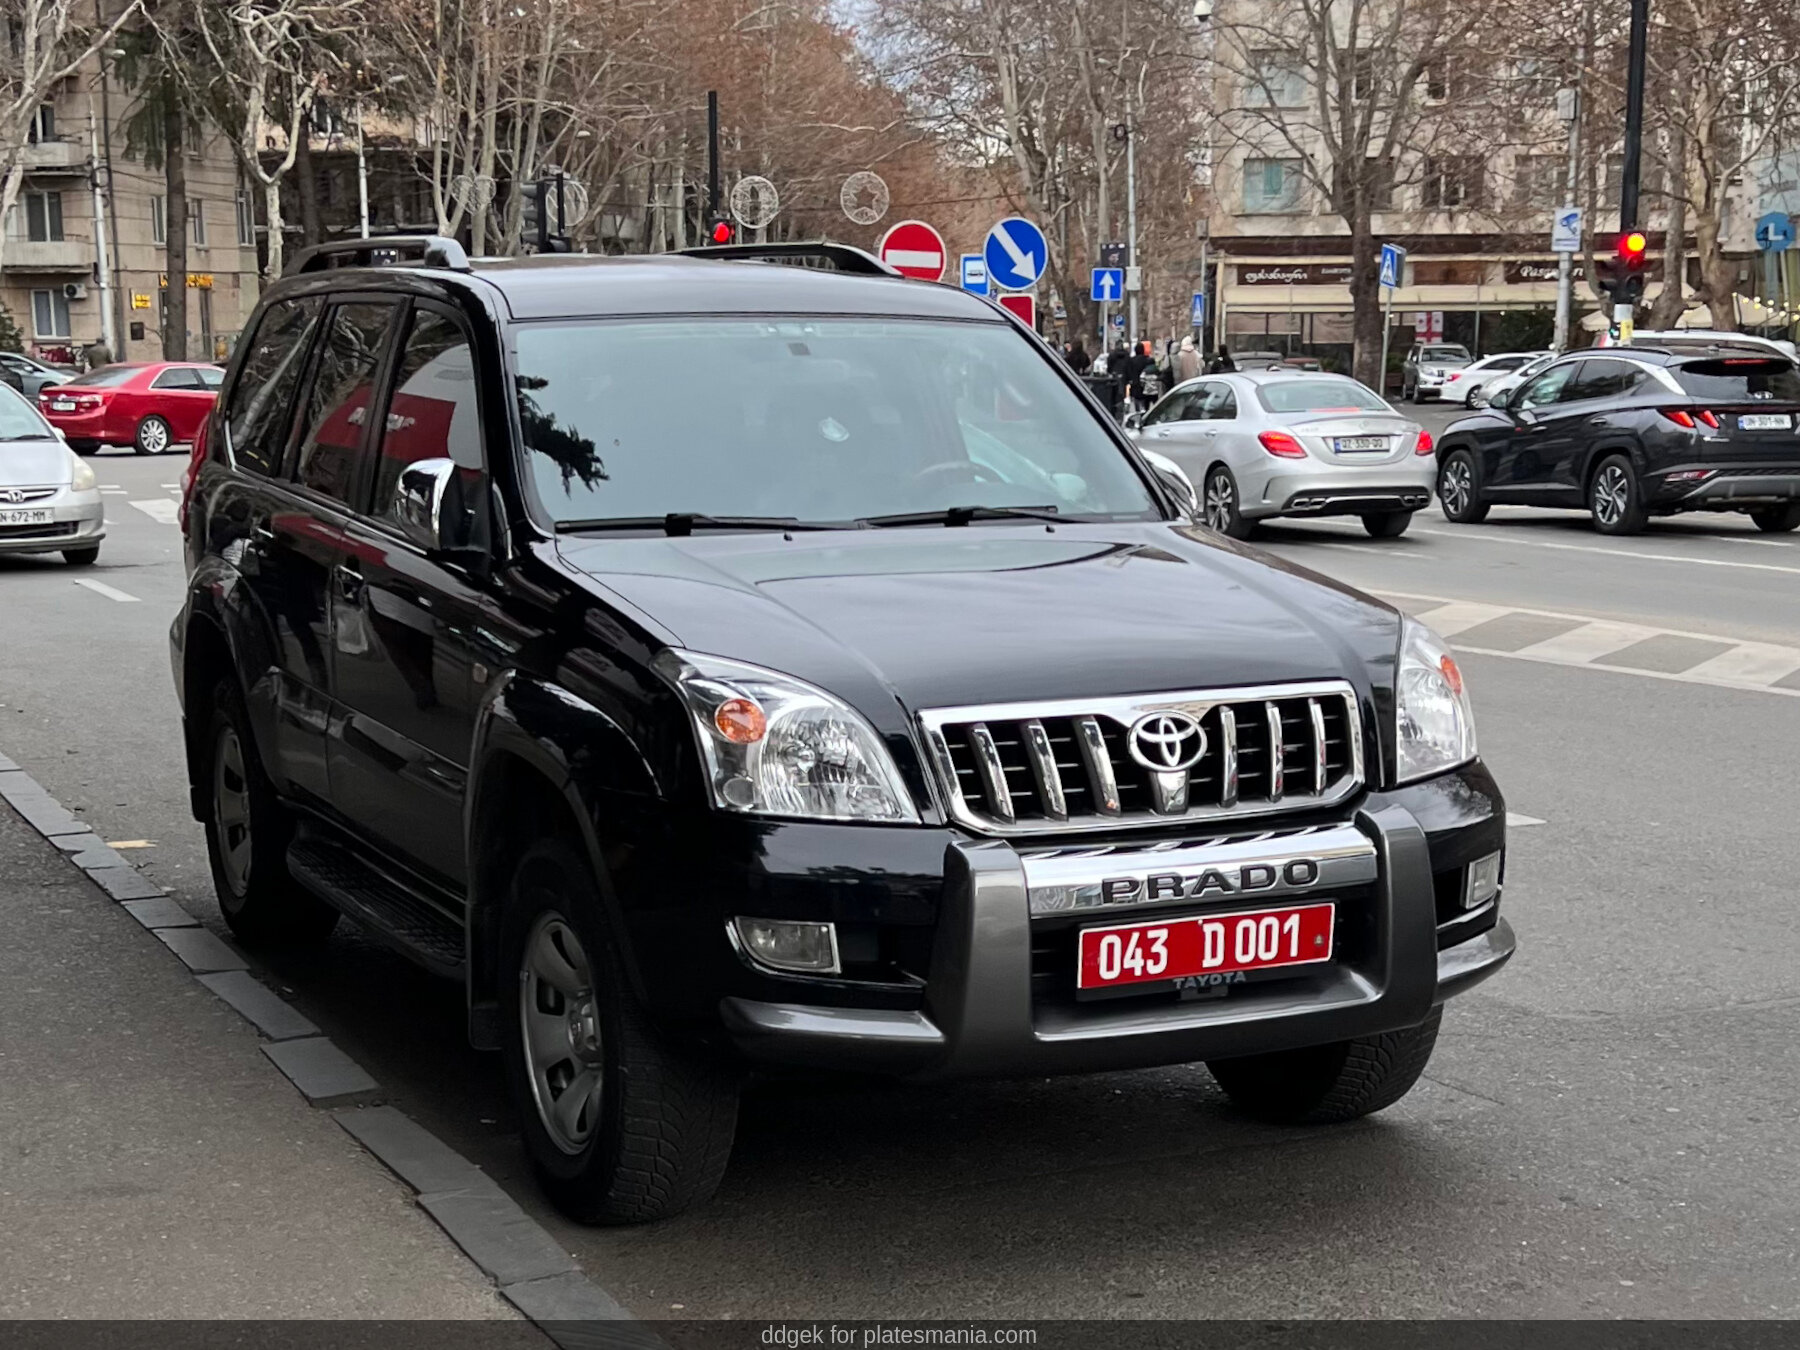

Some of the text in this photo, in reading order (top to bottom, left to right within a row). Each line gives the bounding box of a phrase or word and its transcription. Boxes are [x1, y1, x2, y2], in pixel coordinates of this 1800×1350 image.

[1101, 858, 1320, 904] PRADO
[1098, 928, 1169, 981] 043
[1172, 970, 1247, 990] TAYOTA
